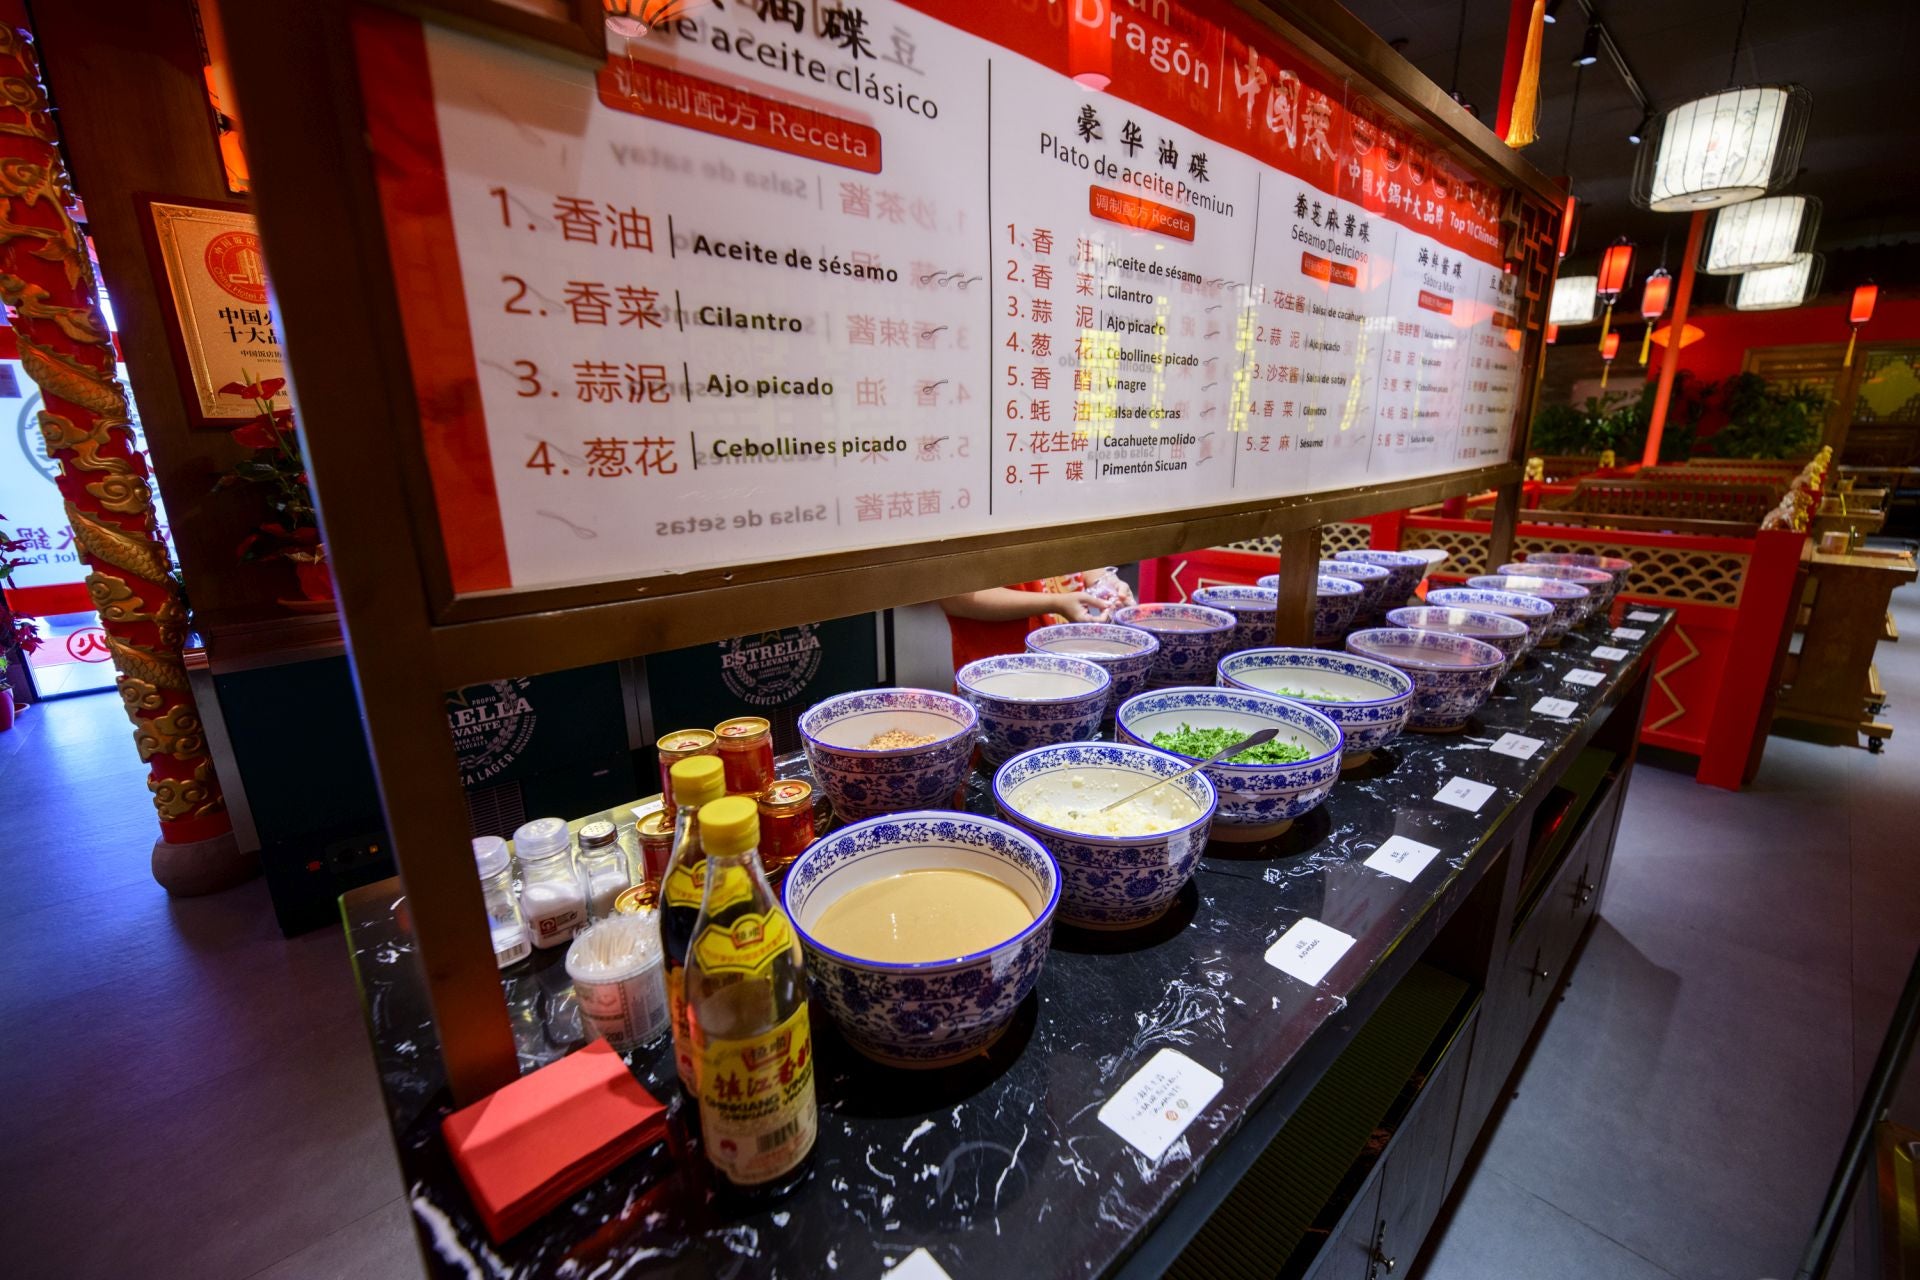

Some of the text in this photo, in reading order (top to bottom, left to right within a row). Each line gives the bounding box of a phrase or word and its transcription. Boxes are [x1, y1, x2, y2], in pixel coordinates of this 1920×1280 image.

[711, 24, 826, 83] aceite
[835, 65, 938, 120] clásico
[769, 110, 868, 159] Receta
[1077, 103, 1210, 183] 豪华油碟
[1040, 132, 1234, 218] Plato de aceite Premiun
[490, 186, 898, 282] 1. 香油 Aceite de sésamo
[1151, 207, 1191, 233] Receta
[1450, 211, 1466, 233] Top
[1006, 223, 1025, 248] 1.
[1108, 253, 1146, 273] Aceite
[1149, 261, 1164, 276] de
[1166, 265, 1203, 285] sésamo
[1291, 223, 1369, 264] Sésamo Delicioso
[1006, 259, 1154, 305] 2. 香菜 Cilantro
[501, 274, 803, 333] 2. 香菜 Cilantro
[1007, 295, 1166, 335] 3. 蒜泥 Ajo picado
[1005, 331, 1026, 353] 4.
[1106, 346, 1162, 365] Cebollines
[1165, 352, 1199, 367] picado
[513, 359, 834, 404] 3. 蒜泥 Ajo picado
[1006, 365, 1025, 387] 5.
[1106, 377, 1147, 394] Vinagre
[1006, 399, 1025, 420] 6.
[1105, 406, 1133, 420] Salsa
[1134, 407, 1147, 420] de
[525, 440, 570, 477] 4.
[582, 435, 679, 478] 葱花
[712, 435, 837, 460] Cebollines
[842, 434, 907, 457] picado
[1006, 430, 1196, 453] 7. 花生碎 Cacahuete molido
[1005, 459, 1188, 485] 8. 干碟 Pimentón Sicuan
[721, 635, 821, 669] ESTRELLA
[746, 653, 800, 671] DE LEVANTE
[744, 692, 782, 706] CERVEZA
[477, 753, 515, 781] LAGER
